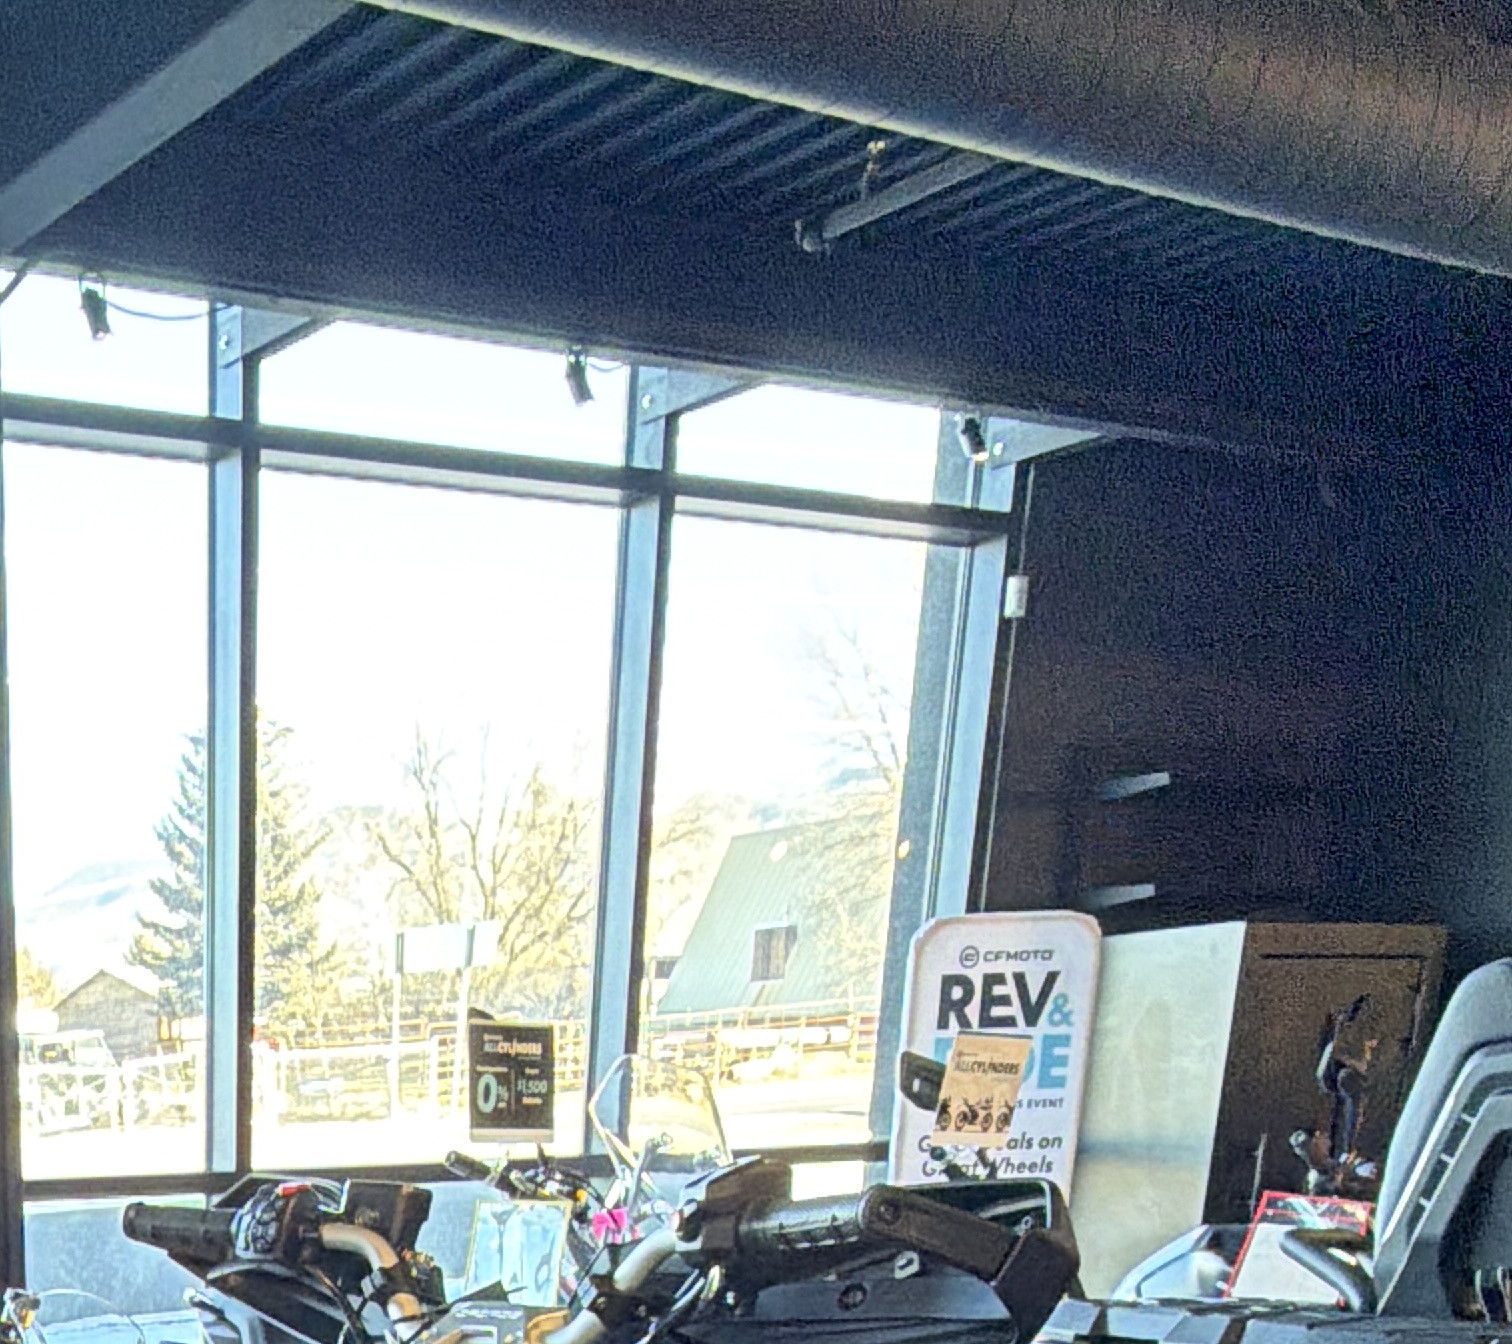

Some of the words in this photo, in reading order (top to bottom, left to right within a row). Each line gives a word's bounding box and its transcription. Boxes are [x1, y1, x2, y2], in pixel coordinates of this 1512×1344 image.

[982, 948, 1055, 963] CFMOTO
[936, 970, 1061, 1030] REV
[1047, 993, 1074, 1028] &
[1026, 1098, 1065, 1109] EVENT
[1005, 1131, 1034, 1150] als
[1038, 1135, 1064, 1150] on
